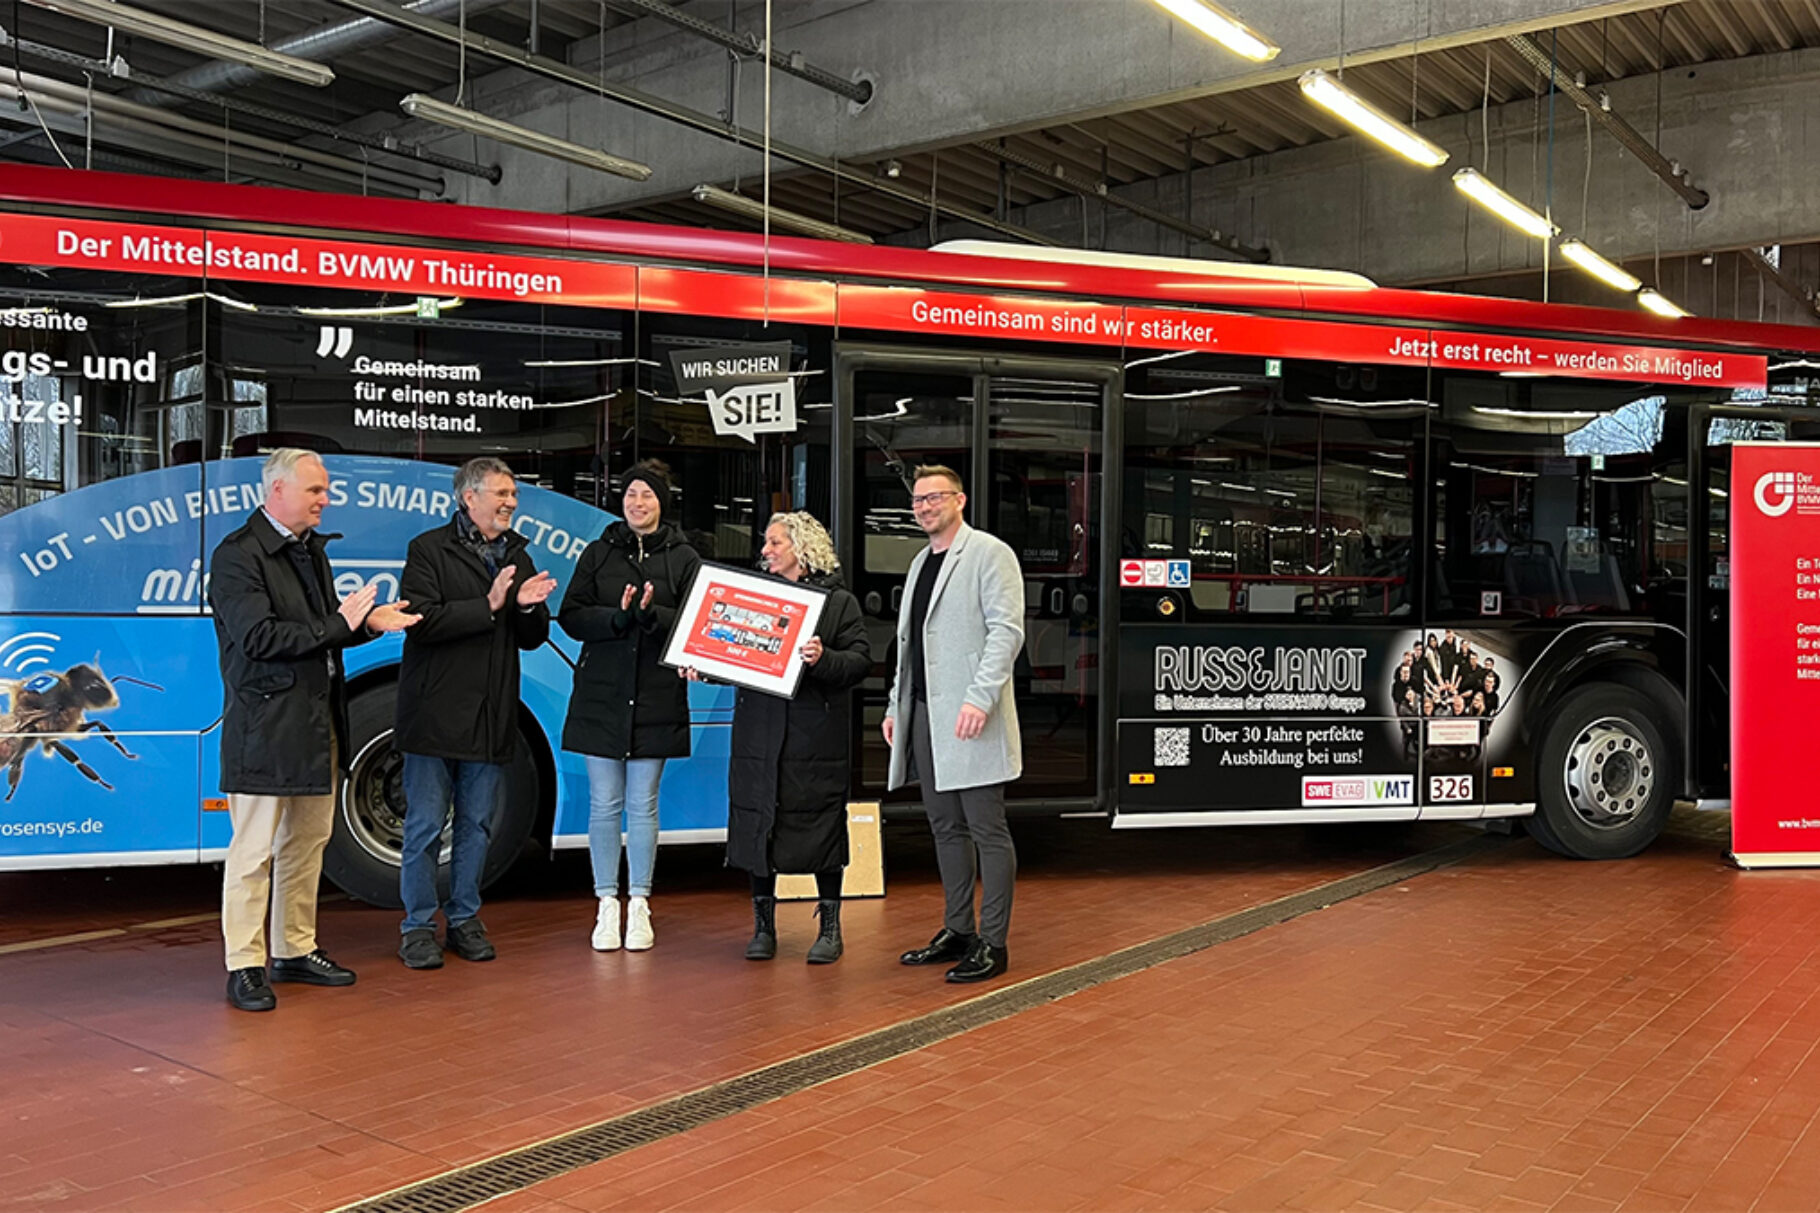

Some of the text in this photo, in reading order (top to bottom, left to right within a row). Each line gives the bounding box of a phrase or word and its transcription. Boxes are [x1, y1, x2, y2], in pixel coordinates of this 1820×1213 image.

[57, 230, 562, 296] Der Mittelstand. BVMW Thüringen
[0, 311, 88, 331] ssante
[911, 300, 1219, 343] Gemeinsam sind wir stärker.
[82, 351, 157, 383] und
[354, 356, 481, 382] Gemeinsam
[681, 355, 780, 379] WIR SUCHEN
[1389, 336, 1438, 359] Jetzt
[1443, 343, 1480, 362] erst
[1484, 344, 1532, 365] recht
[1554, 351, 1618, 371] werden
[1622, 354, 1650, 373] Sie
[1655, 356, 1724, 381] Mitglied
[354, 381, 535, 411] für einen starken
[723, 391, 782, 427] SIE!
[0, 393, 83, 426] tze!
[354, 408, 482, 433] Mittelstand.
[99, 497, 179, 541] VON
[184, 482, 264, 520] BIEN
[356, 481, 458, 519] SMAR
[1154, 646, 1368, 693] RUSS&JANOT
[1201, 724, 1364, 746] Über 30 Jahre perfekte
[1220, 749, 1364, 768] Ausbildung bei uns!
[1308, 784, 1332, 798] SWE
[1373, 780, 1410, 799] VMT
[1432, 778, 1471, 799] 326
[0, 817, 104, 839] osensys.de
